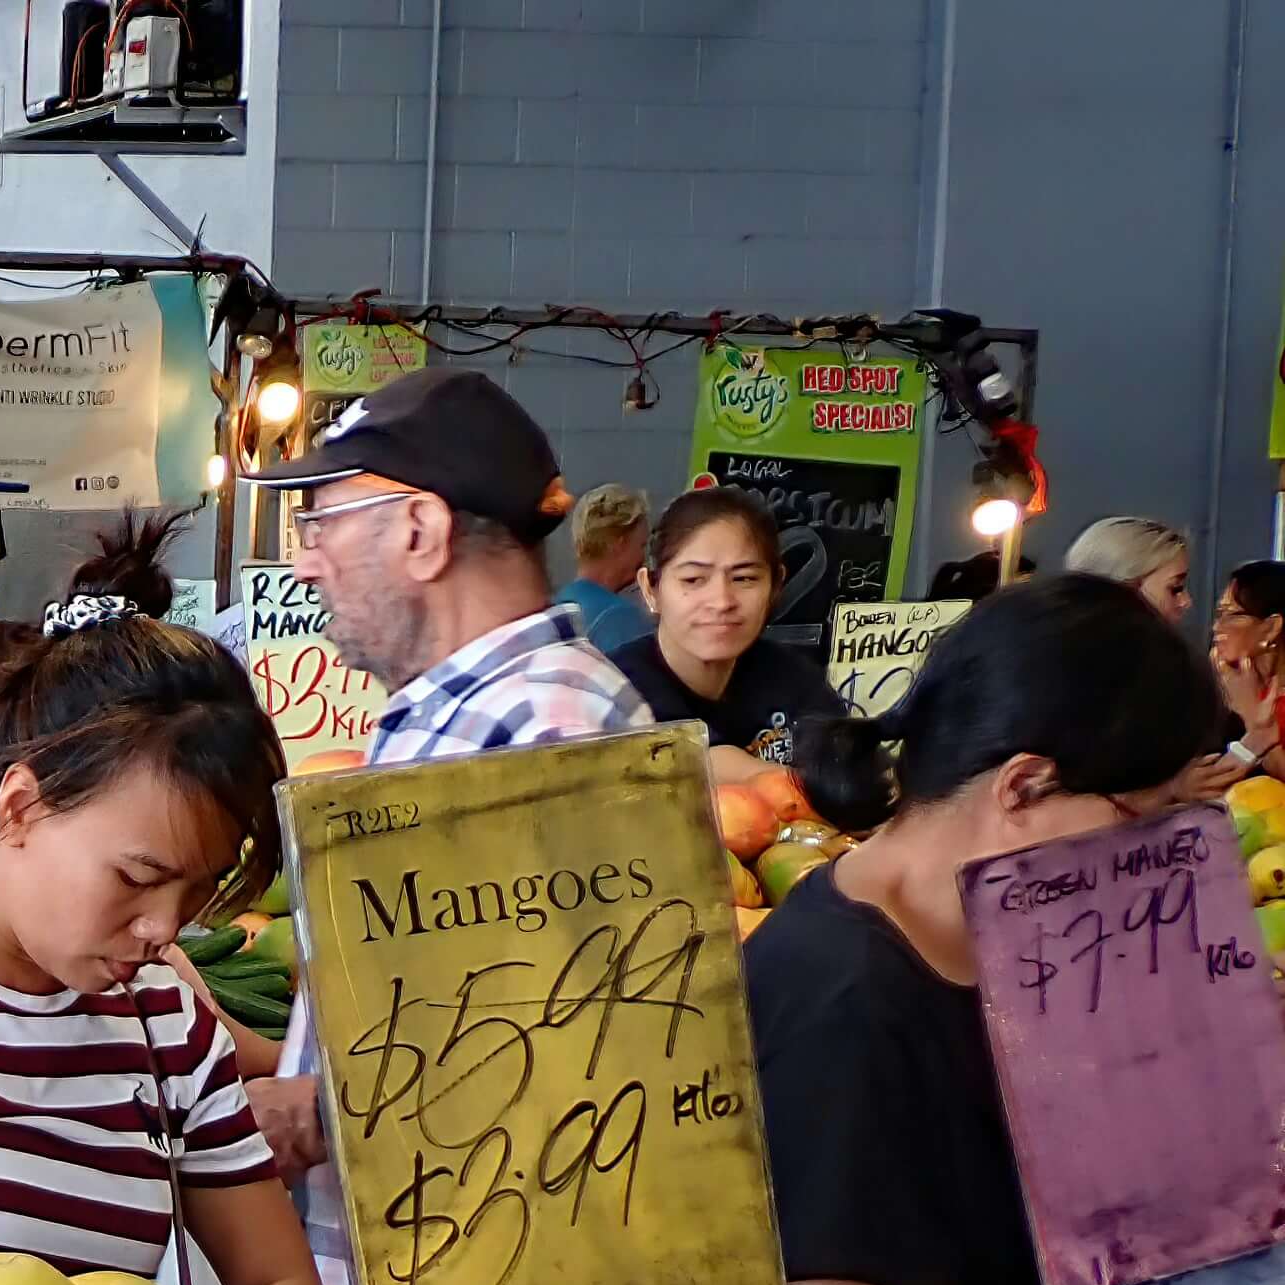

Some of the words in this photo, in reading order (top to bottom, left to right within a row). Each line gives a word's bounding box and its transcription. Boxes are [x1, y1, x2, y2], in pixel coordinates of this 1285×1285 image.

[803, 364, 845, 393] RED
[848, 365, 899, 393] SPOT
[344, 801, 422, 838] R2E2
[350, 856, 654, 944] Mangoes
[1017, 867, 1202, 1015] $7.99
